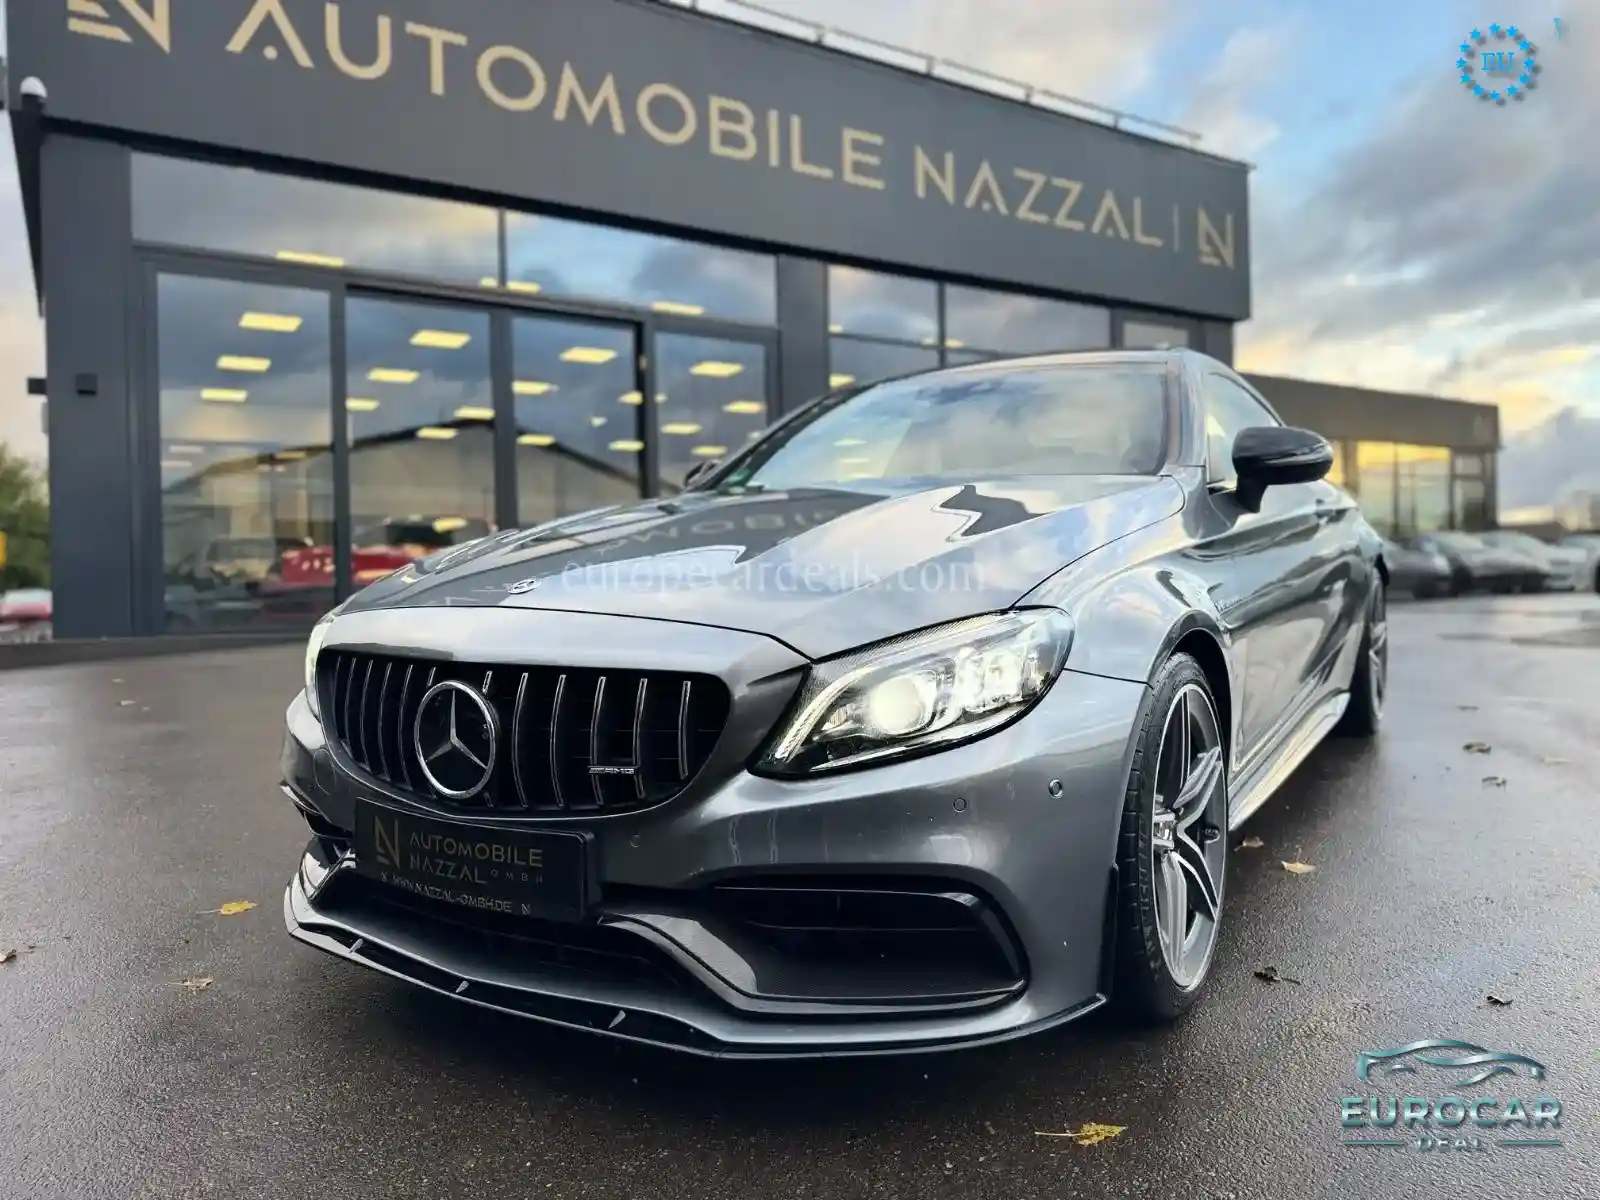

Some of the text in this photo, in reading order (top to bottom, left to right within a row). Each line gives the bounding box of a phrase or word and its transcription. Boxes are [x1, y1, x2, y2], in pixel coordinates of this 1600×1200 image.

[225, 0, 885, 191] AUTOMOBILE
[914, 144, 1163, 246] NAZZAL
[409, 831, 544, 867] AUTOMOBILE
[409, 853, 487, 884] NAZZAL
